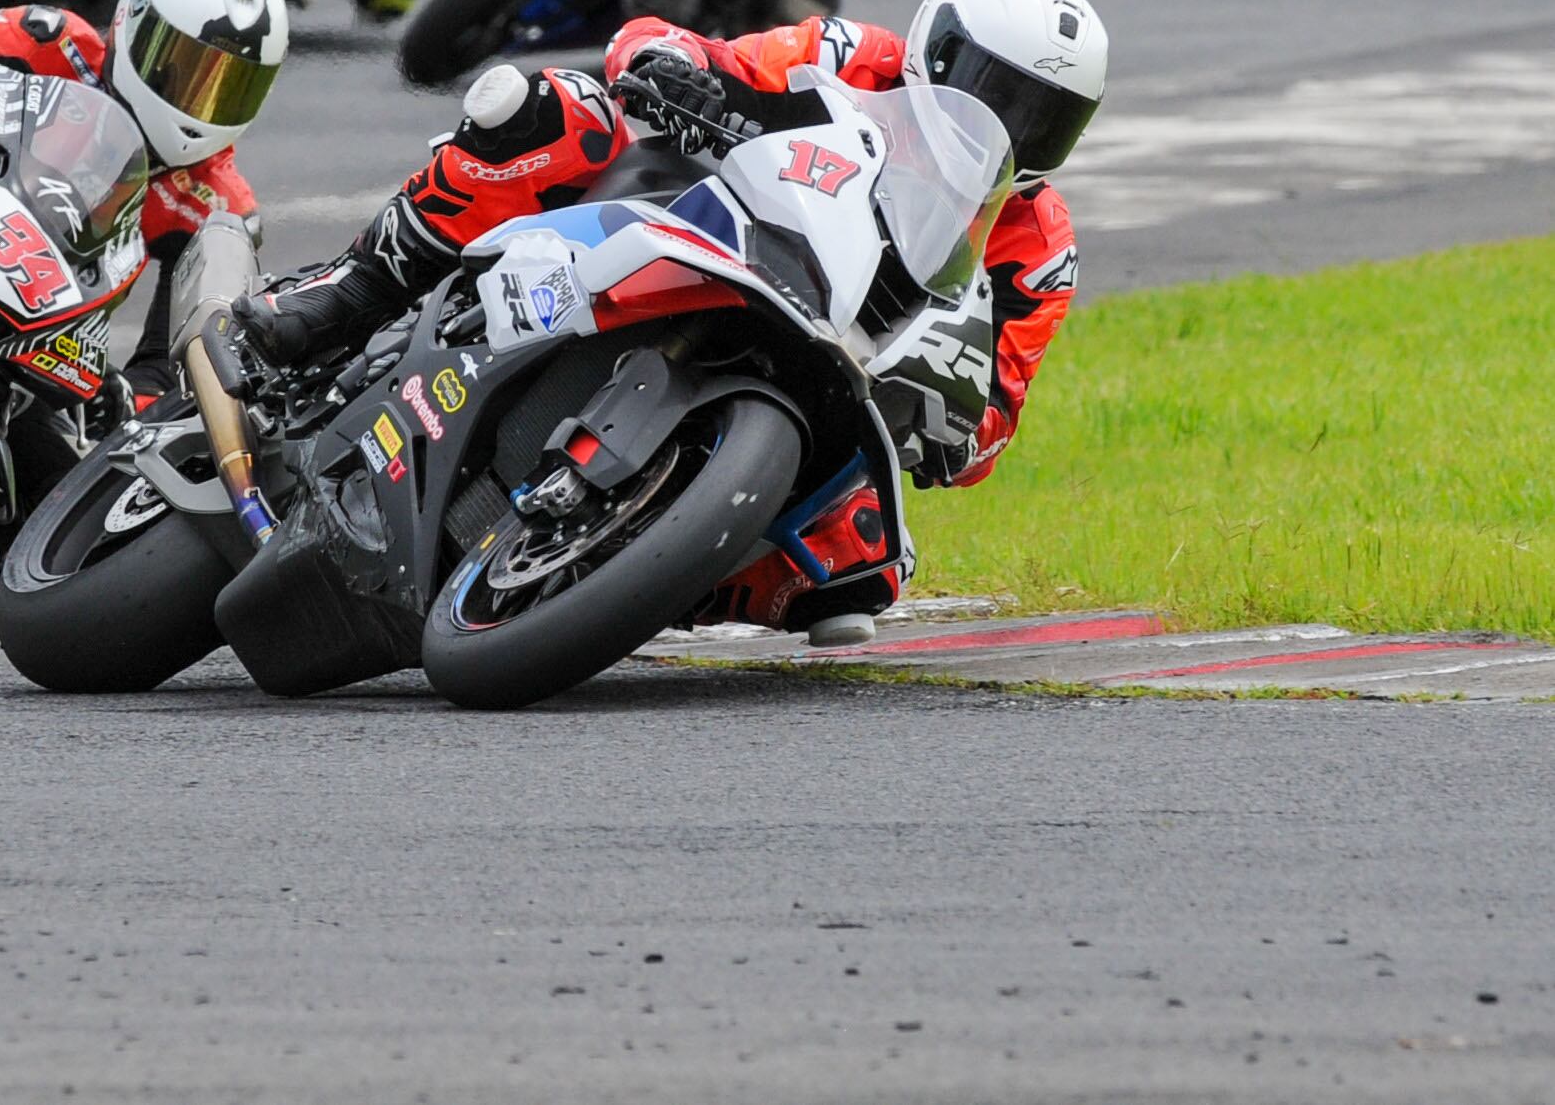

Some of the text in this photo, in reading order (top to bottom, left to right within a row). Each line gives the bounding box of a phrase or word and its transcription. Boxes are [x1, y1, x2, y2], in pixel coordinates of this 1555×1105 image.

[778, 140, 862, 199] 17
[500, 273, 534, 338] RR
[410, 389, 444, 441] brembo
